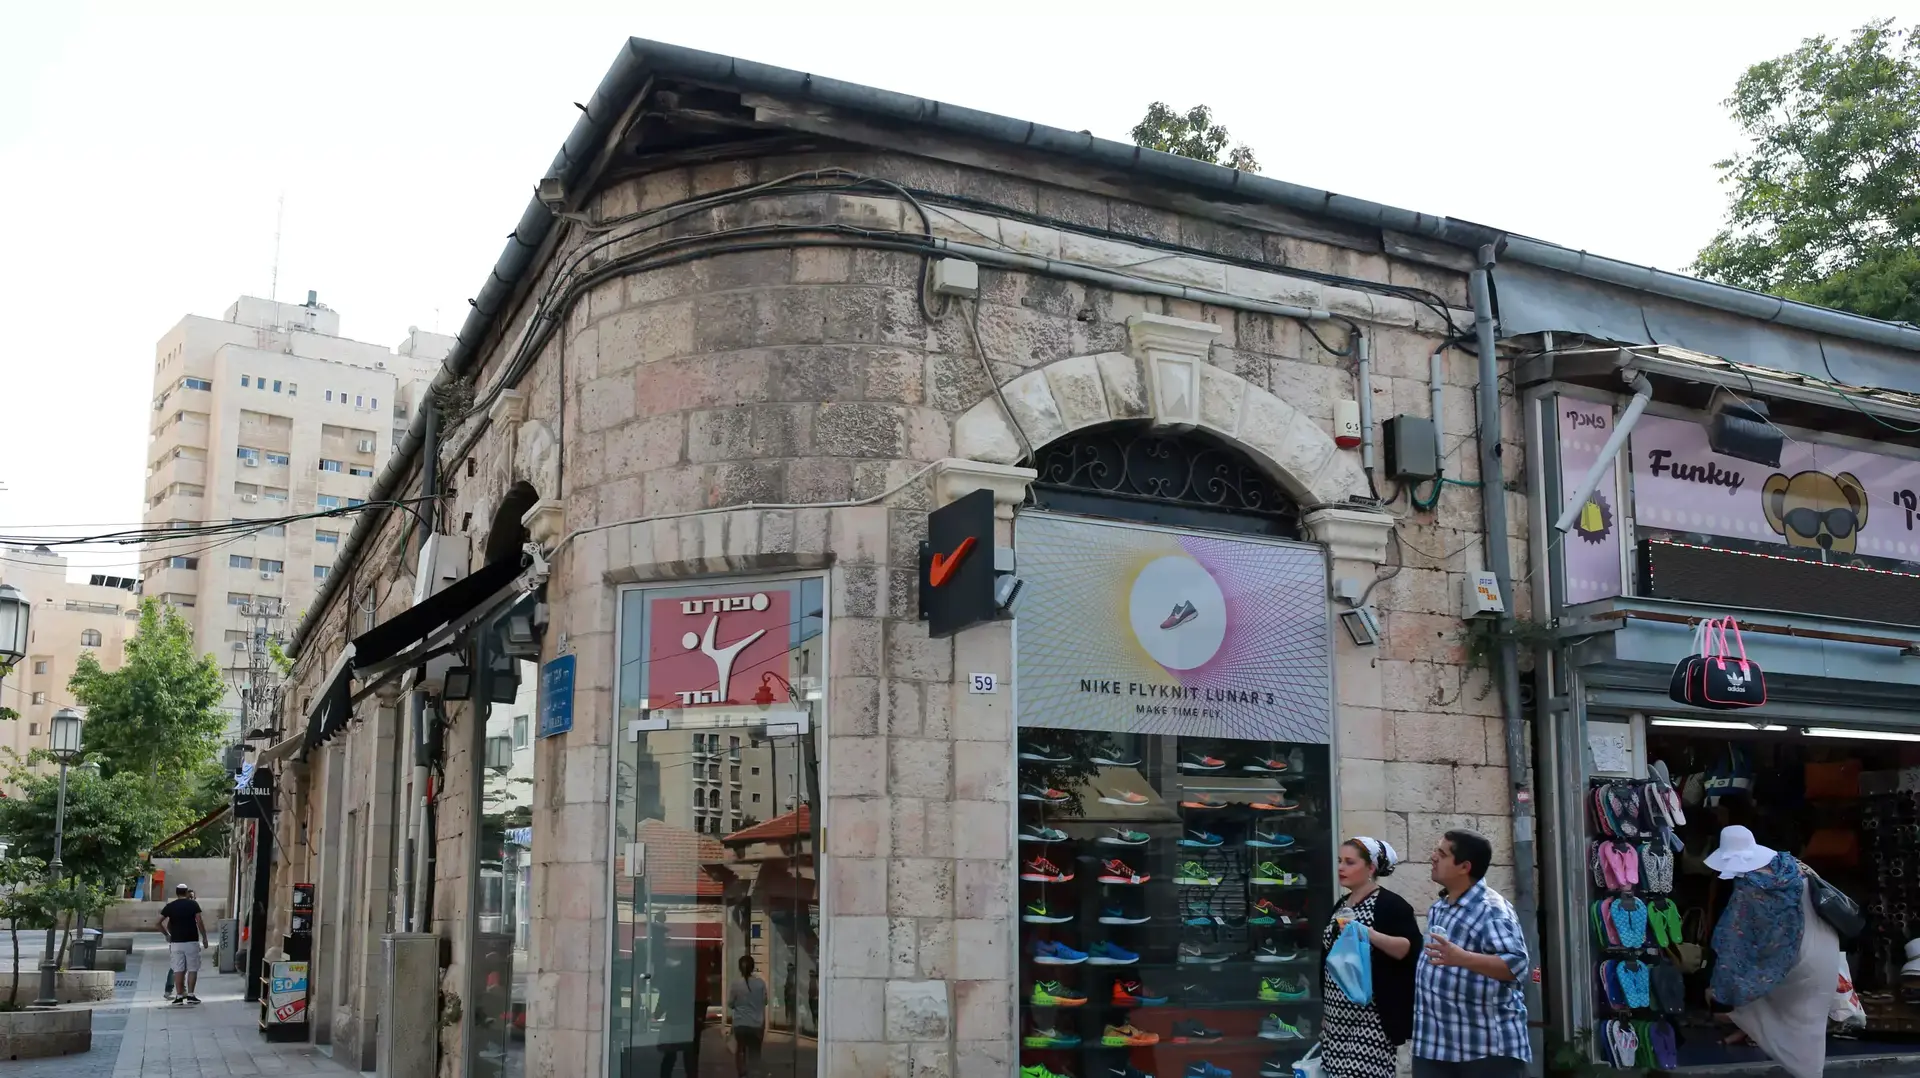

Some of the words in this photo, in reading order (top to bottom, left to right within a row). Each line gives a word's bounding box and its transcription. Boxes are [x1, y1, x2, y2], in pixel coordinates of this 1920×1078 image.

[1648, 449, 1745, 496] Funky
[974, 675, 993, 691] 59
[1080, 679, 1121, 694] NIKE
[1129, 683, 1198, 700] FLYKNIT
[1206, 688, 1260, 704] LUNAR
[1266, 692, 1275, 705] 3
[1136, 704, 1168, 714] MAKE
[1172, 706, 1198, 717] TIME
[275, 979, 293, 990] 30
[277, 1004, 295, 1018] 10
